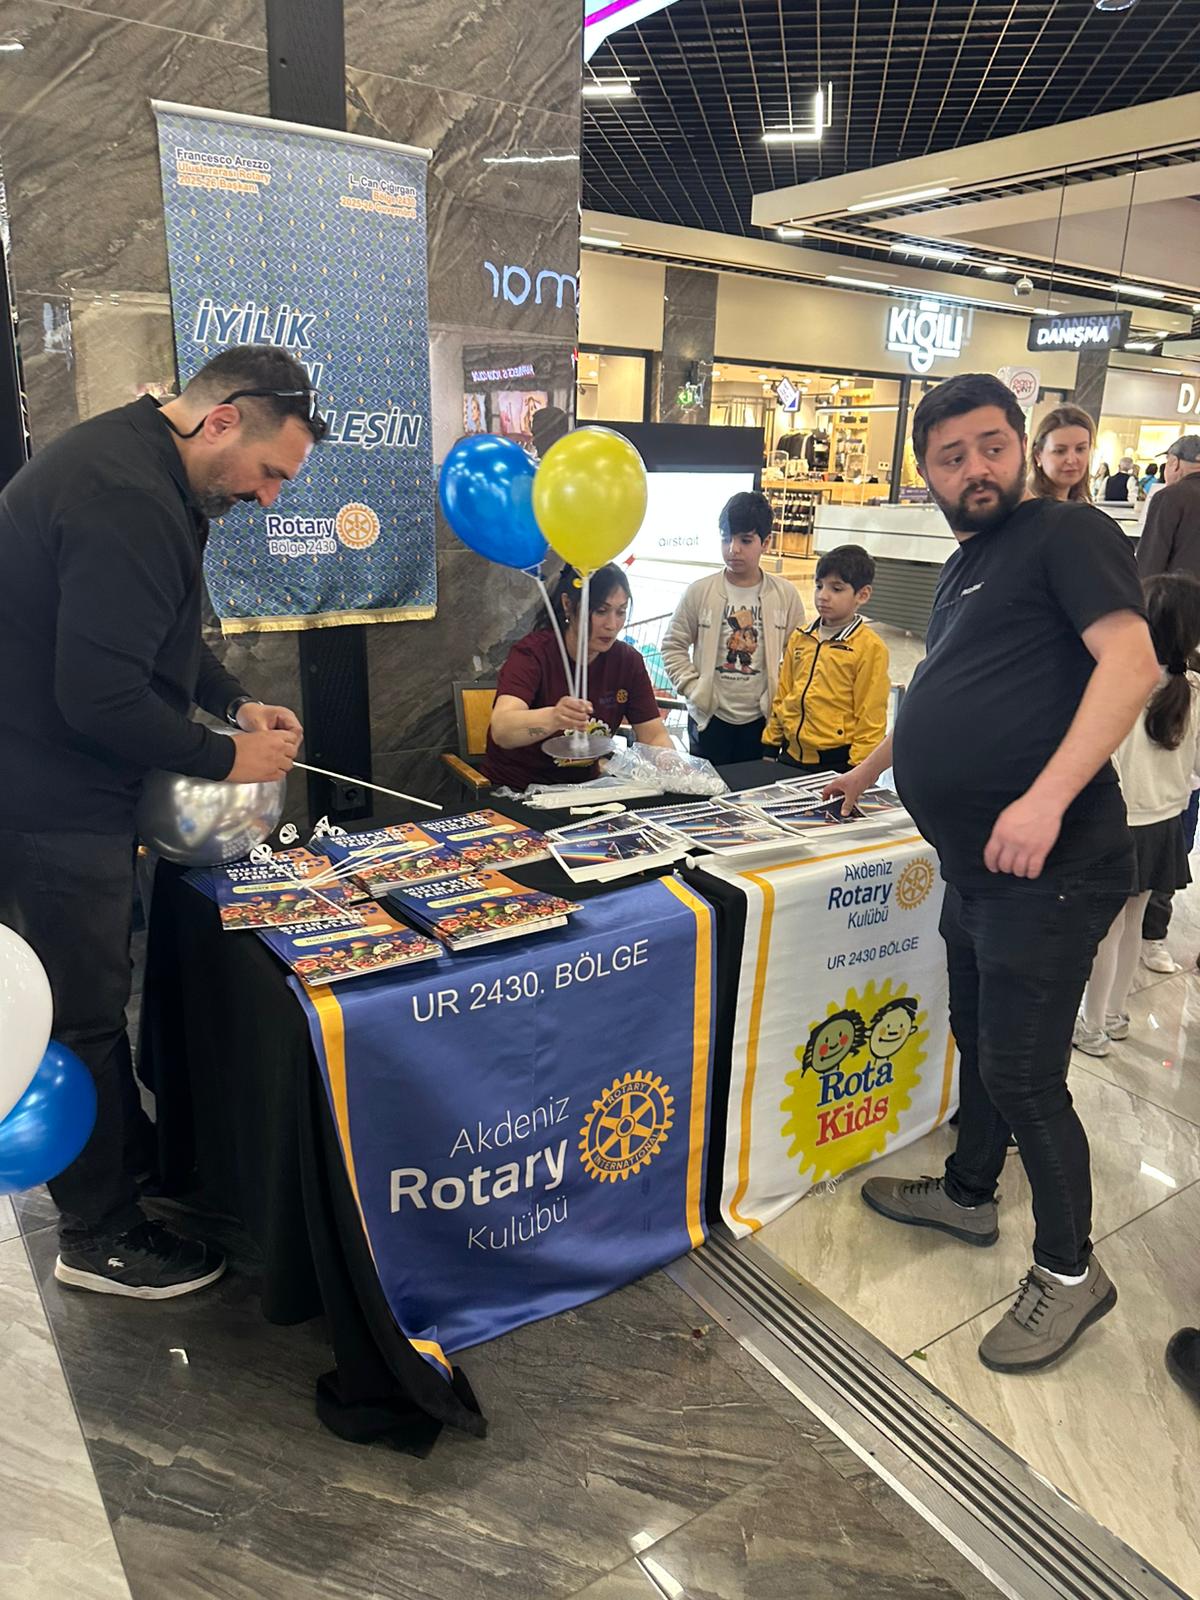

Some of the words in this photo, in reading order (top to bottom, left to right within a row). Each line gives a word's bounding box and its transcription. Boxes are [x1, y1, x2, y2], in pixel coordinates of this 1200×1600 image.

[176, 148, 232, 165] Francesco
[235, 156, 270, 170] Arezzo
[179, 175, 217, 188] 2025-26
[238, 168, 271, 184] Rotary
[361, 176, 378, 188] Can
[194, 298, 316, 348] İYİLİK
[1036, 325, 1110, 347] DANIŞMA
[318, 406, 422, 449] LEŞİN
[267, 515, 334, 539] Rotary
[271, 540, 305, 556] Bölge
[307, 540, 336, 553] 2430
[844, 858, 893, 882] Akdeniz
[828, 882, 893, 910] Rotary
[847, 905, 889, 929] Kulübü
[827, 954, 846, 970] UR
[848, 947, 877, 966] 2430
[879, 936, 920, 959] BÖLGE
[412, 988, 460, 1022] UR
[469, 971, 545, 1011] 2430.
[555, 939, 649, 989] BÖLGE
[607, 1082, 647, 1104] ROTARY
[816, 1060, 894, 1108] Rota
[450, 1096, 570, 1158] Akdeniz
[815, 1096, 889, 1147] Kids
[593, 1133, 659, 1170] INTERNATIONAL
[390, 1139, 568, 1213] Rotary
[467, 1195, 568, 1250] Kulübü
